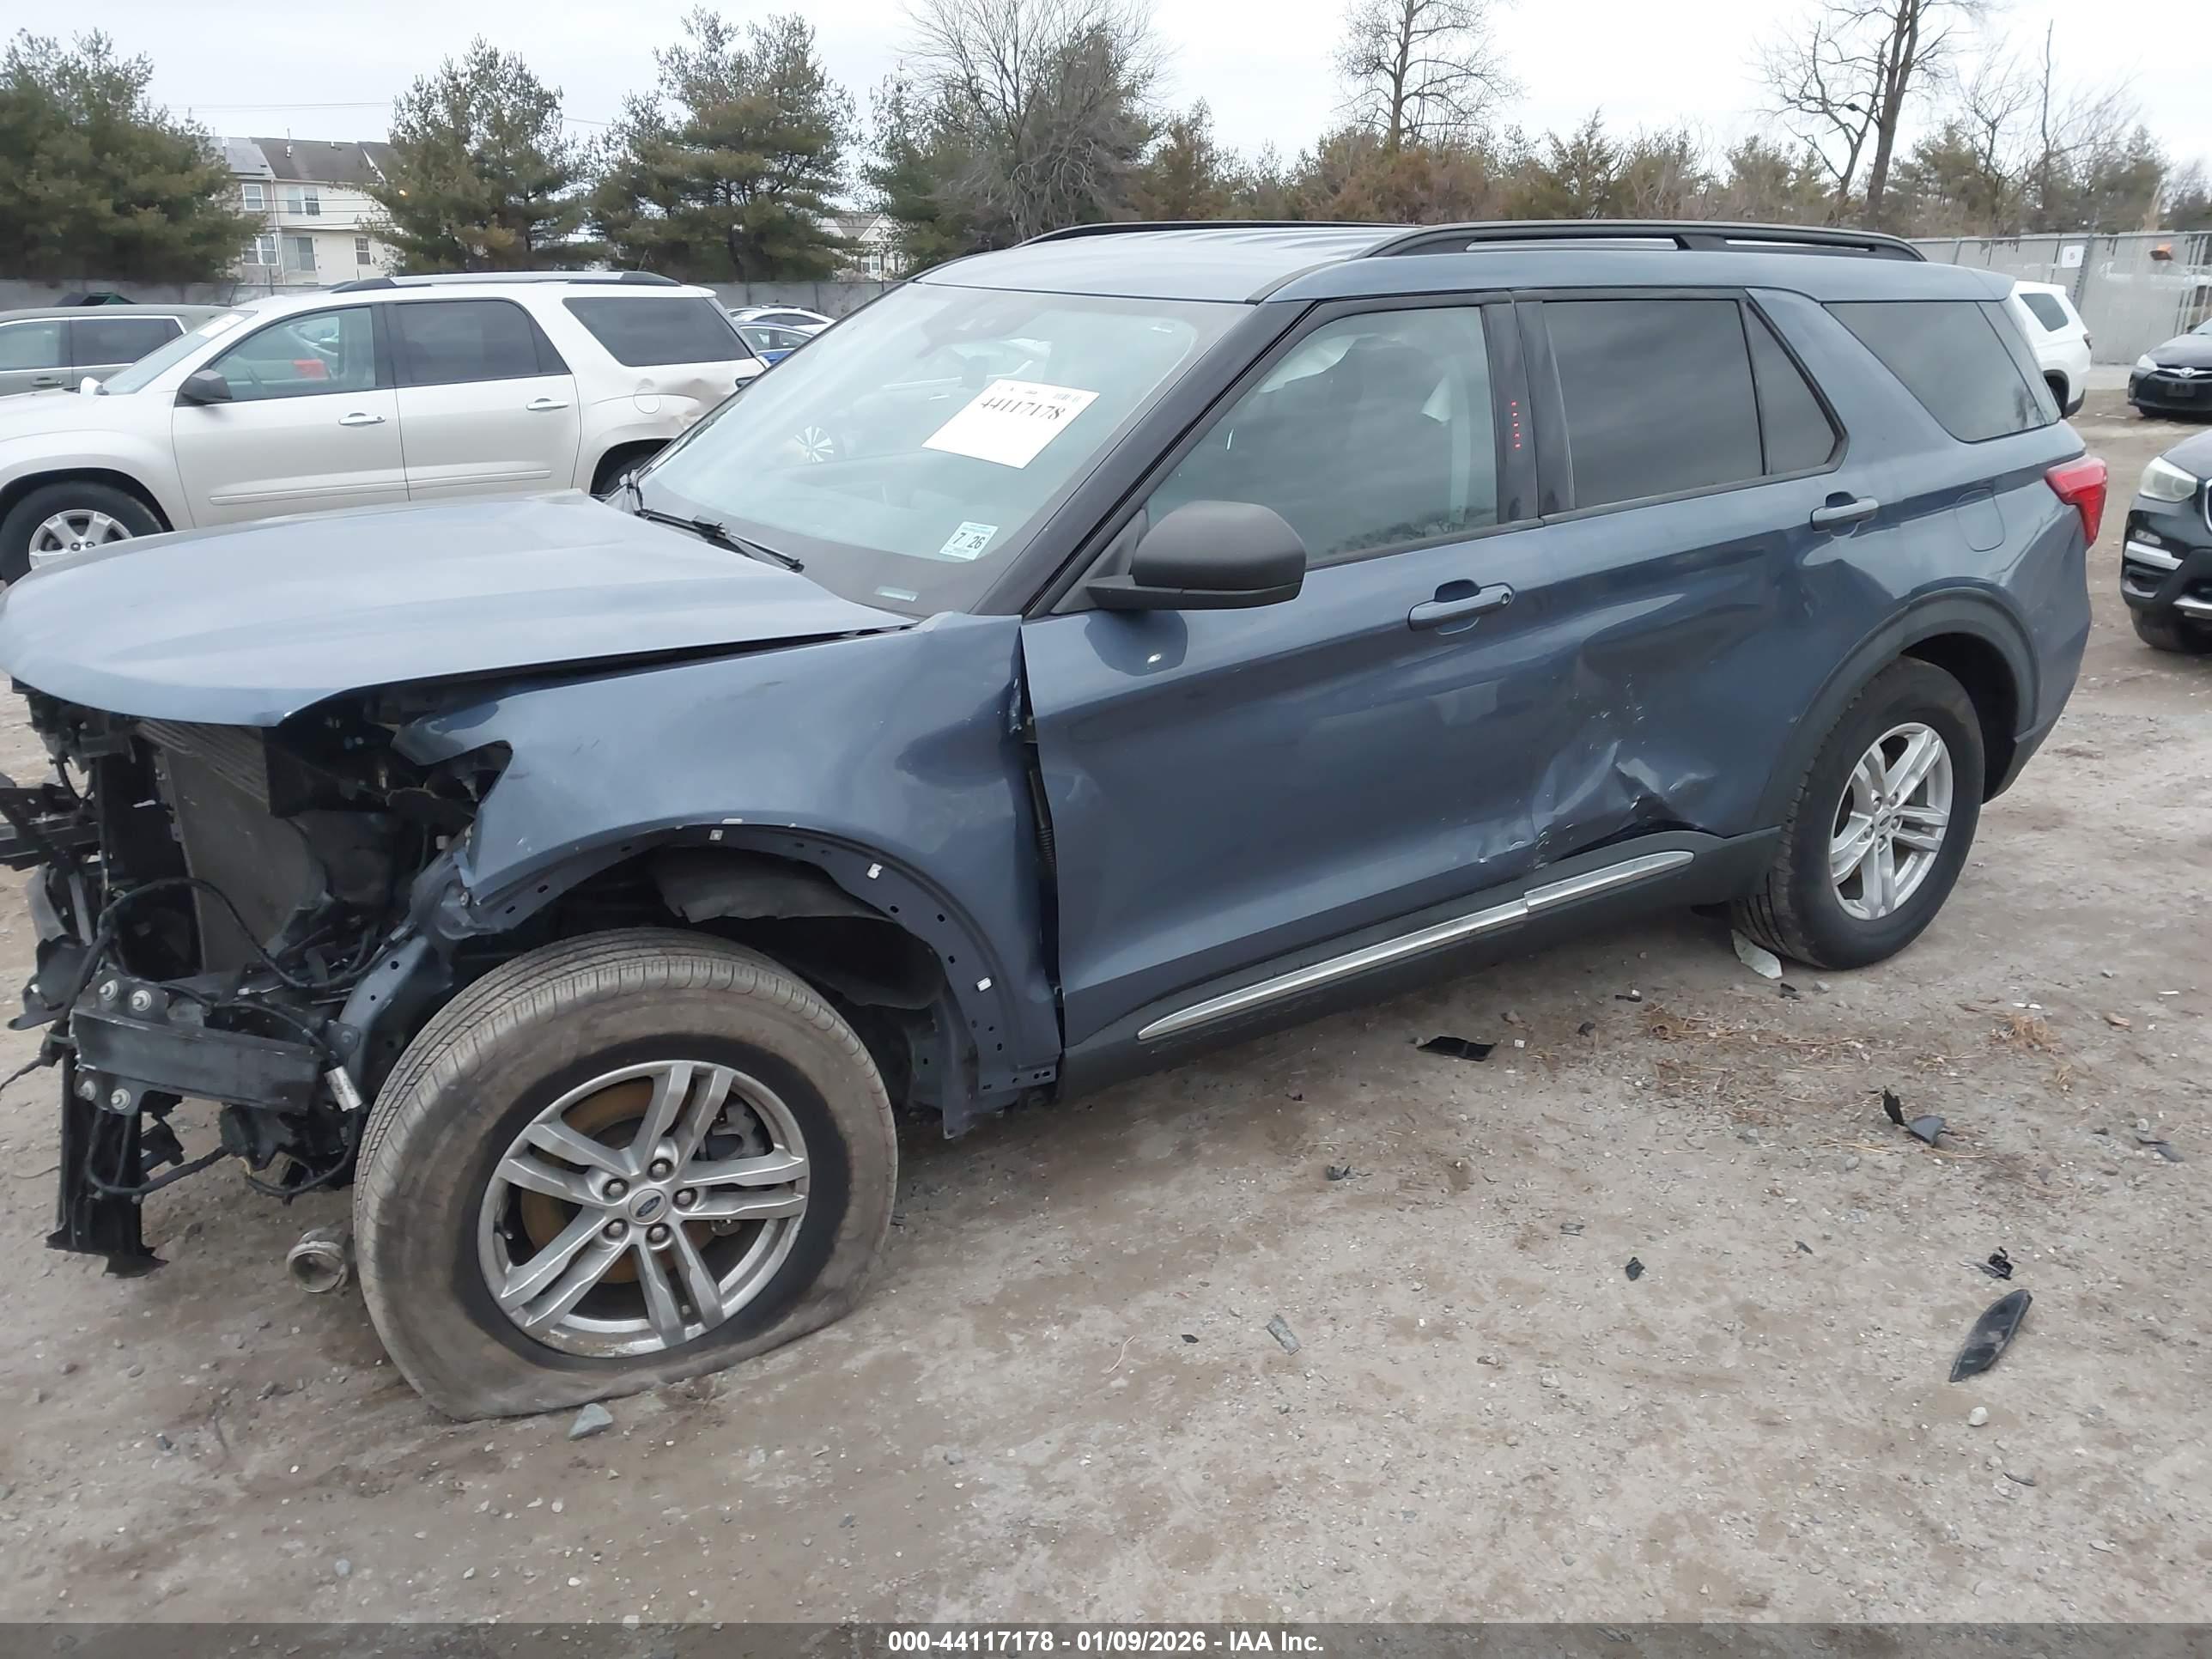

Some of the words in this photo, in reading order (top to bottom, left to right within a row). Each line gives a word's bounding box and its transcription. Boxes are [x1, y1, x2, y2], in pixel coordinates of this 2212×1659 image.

[981, 397, 1066, 419] 44117178
[953, 532, 967, 544] 7
[966, 535, 986, 550] 26
